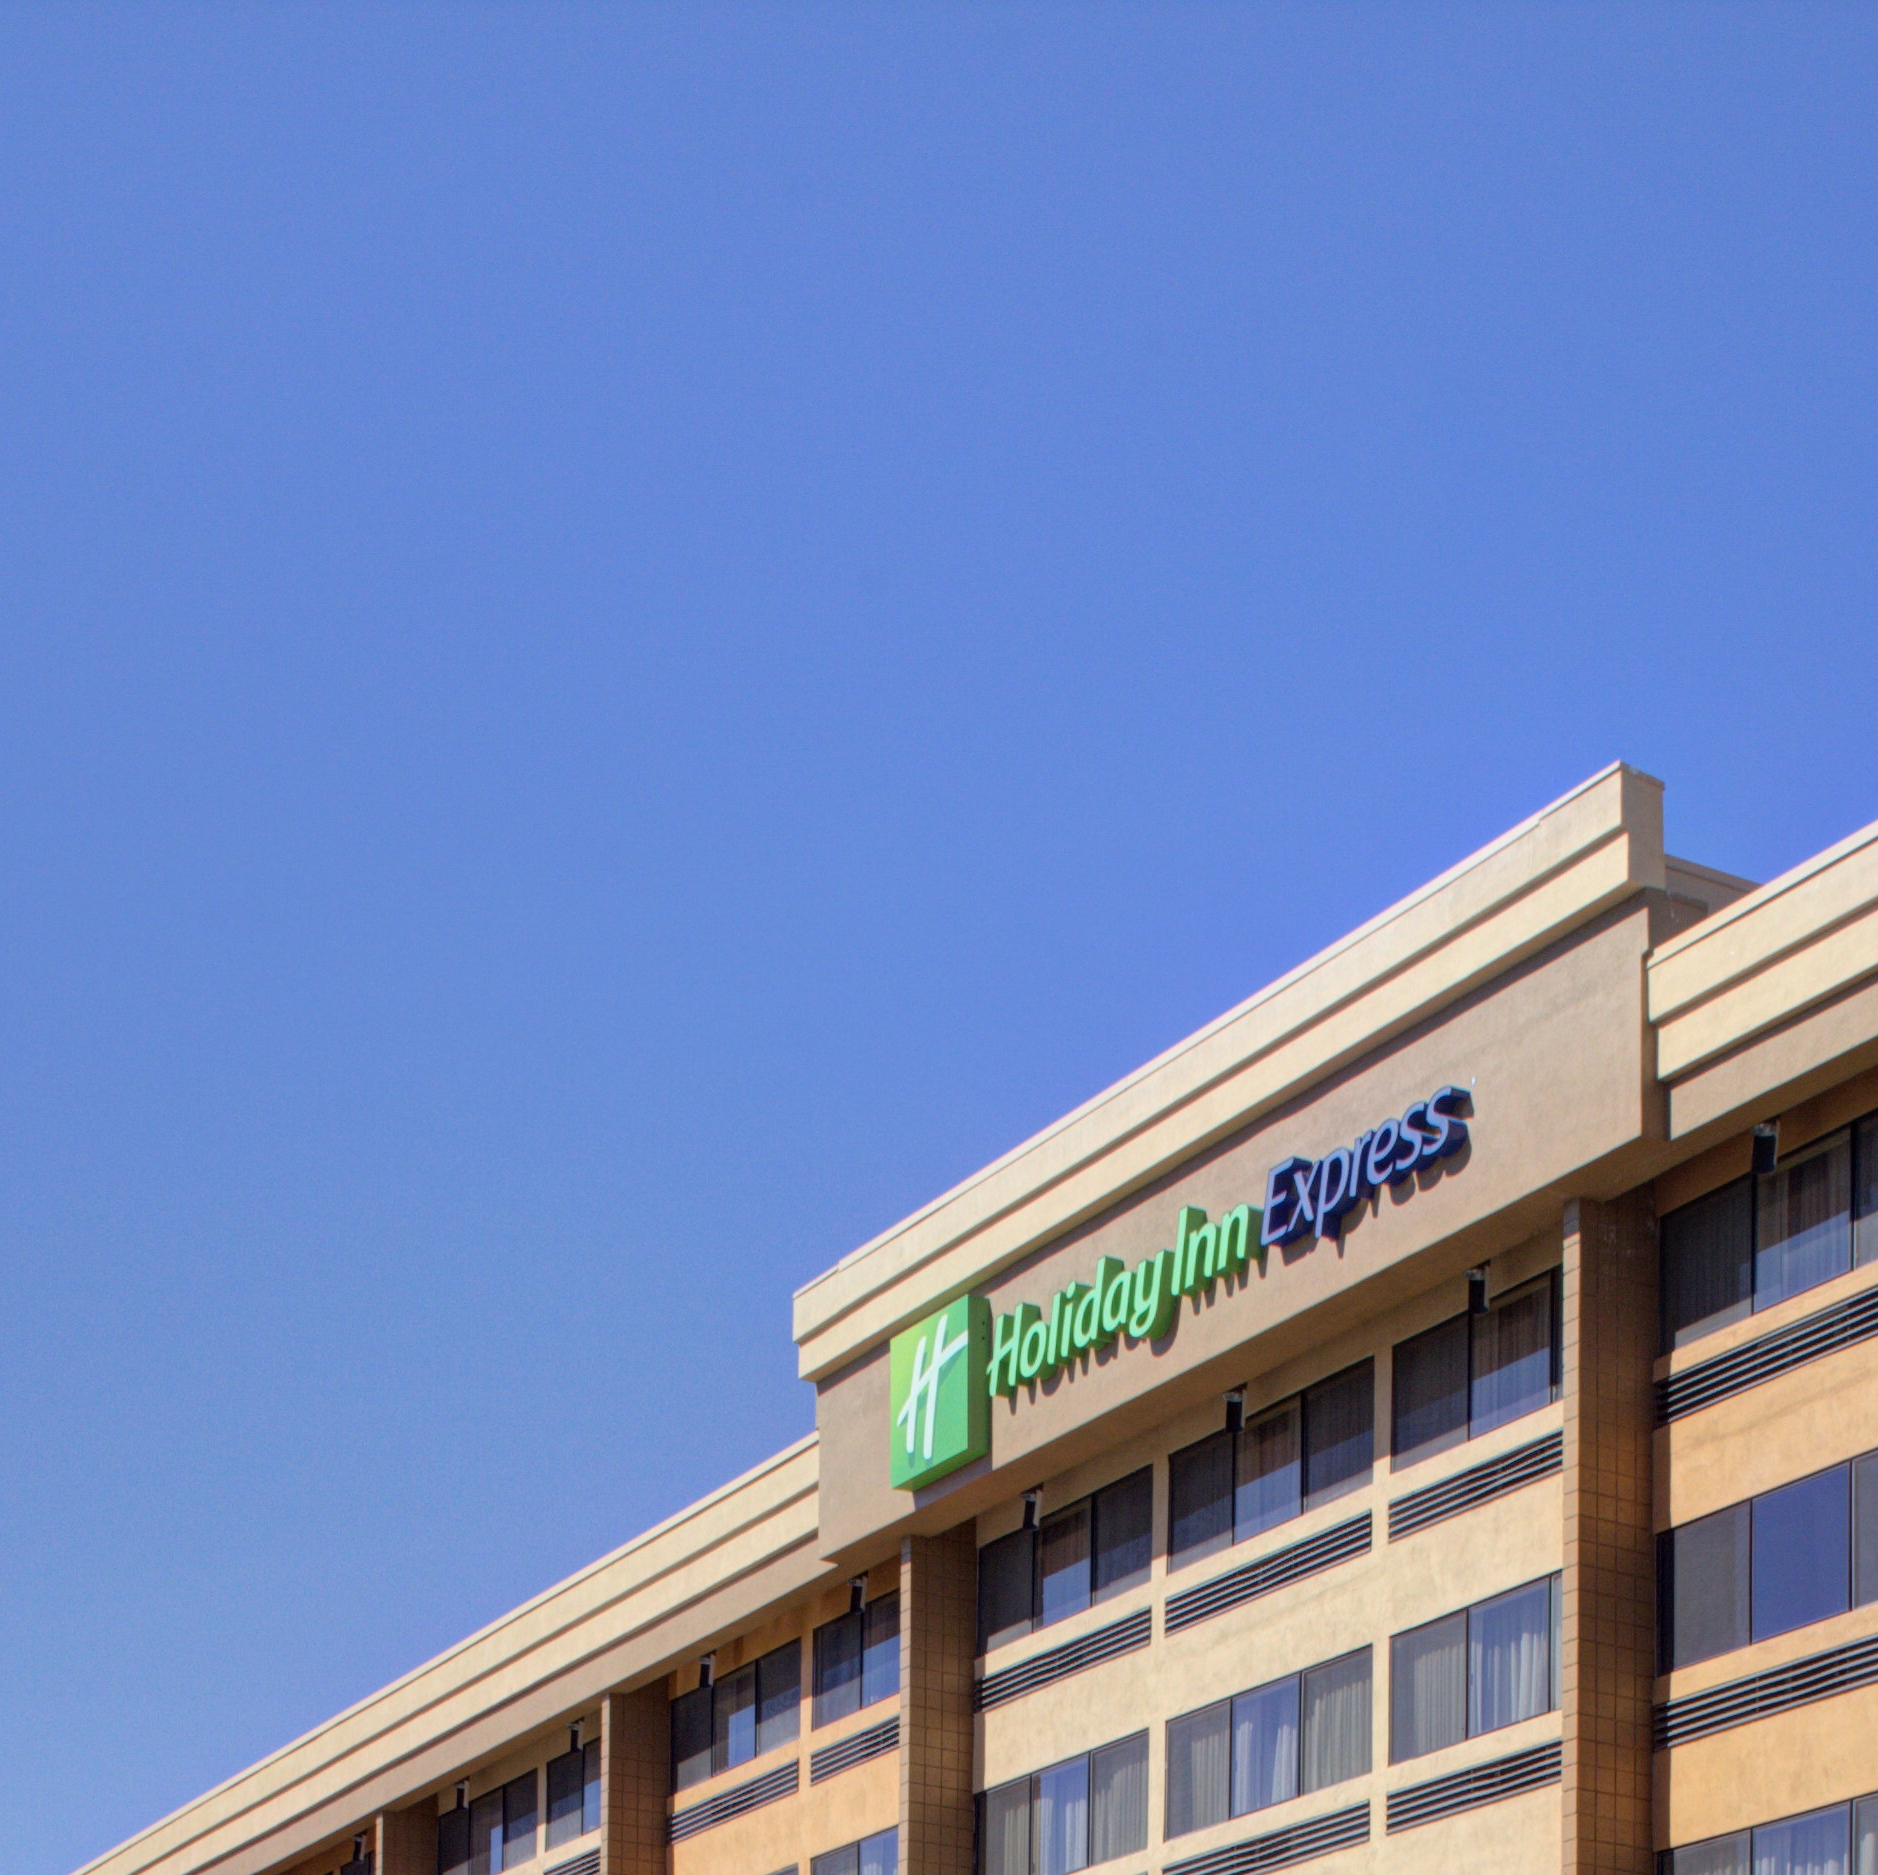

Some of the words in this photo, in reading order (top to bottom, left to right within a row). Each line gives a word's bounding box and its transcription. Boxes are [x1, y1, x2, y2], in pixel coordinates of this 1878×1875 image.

[987, 1255, 1172, 1397] Holiday
[1171, 1204, 1256, 1298] Inn
[1261, 1085, 1473, 1246] Express
